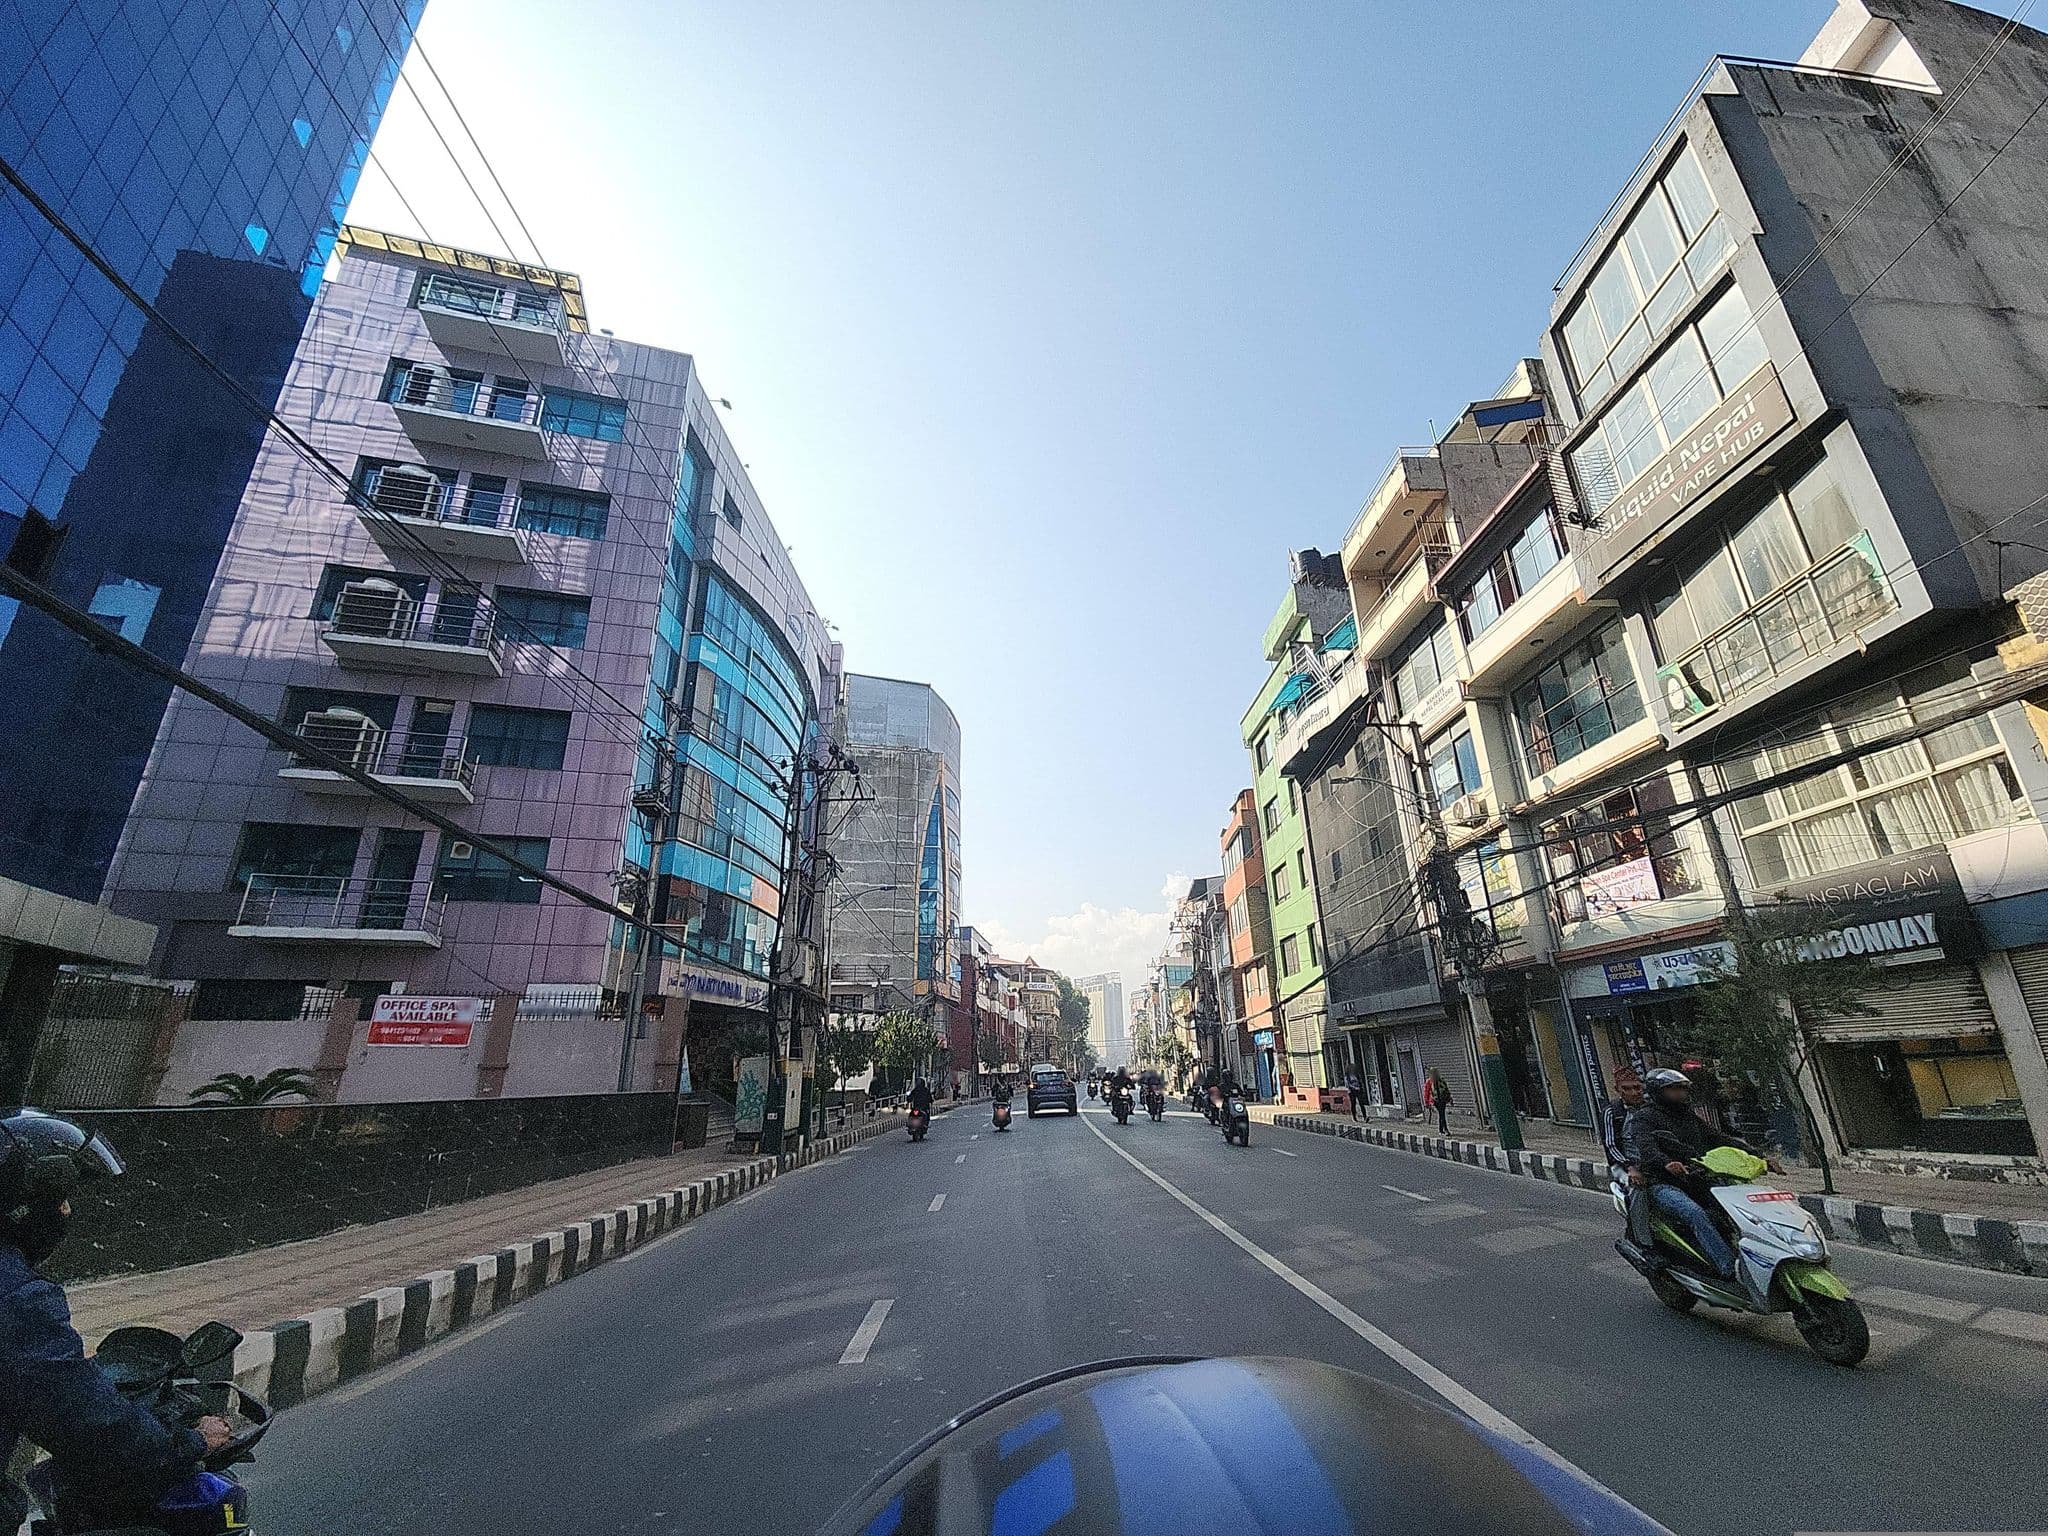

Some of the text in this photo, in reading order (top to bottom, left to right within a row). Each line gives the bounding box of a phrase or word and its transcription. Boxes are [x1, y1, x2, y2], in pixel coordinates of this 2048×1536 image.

[1678, 392, 1757, 472] Nepal
[1671, 421, 1765, 504] VAPE HUB
[1806, 865, 1940, 911] INSTAGLAM
[696, 975, 743, 998] NATIONAL
[381, 1000, 471, 1012] OFFICE SPA
[389, 1011, 458, 1022] AVAILABLE
